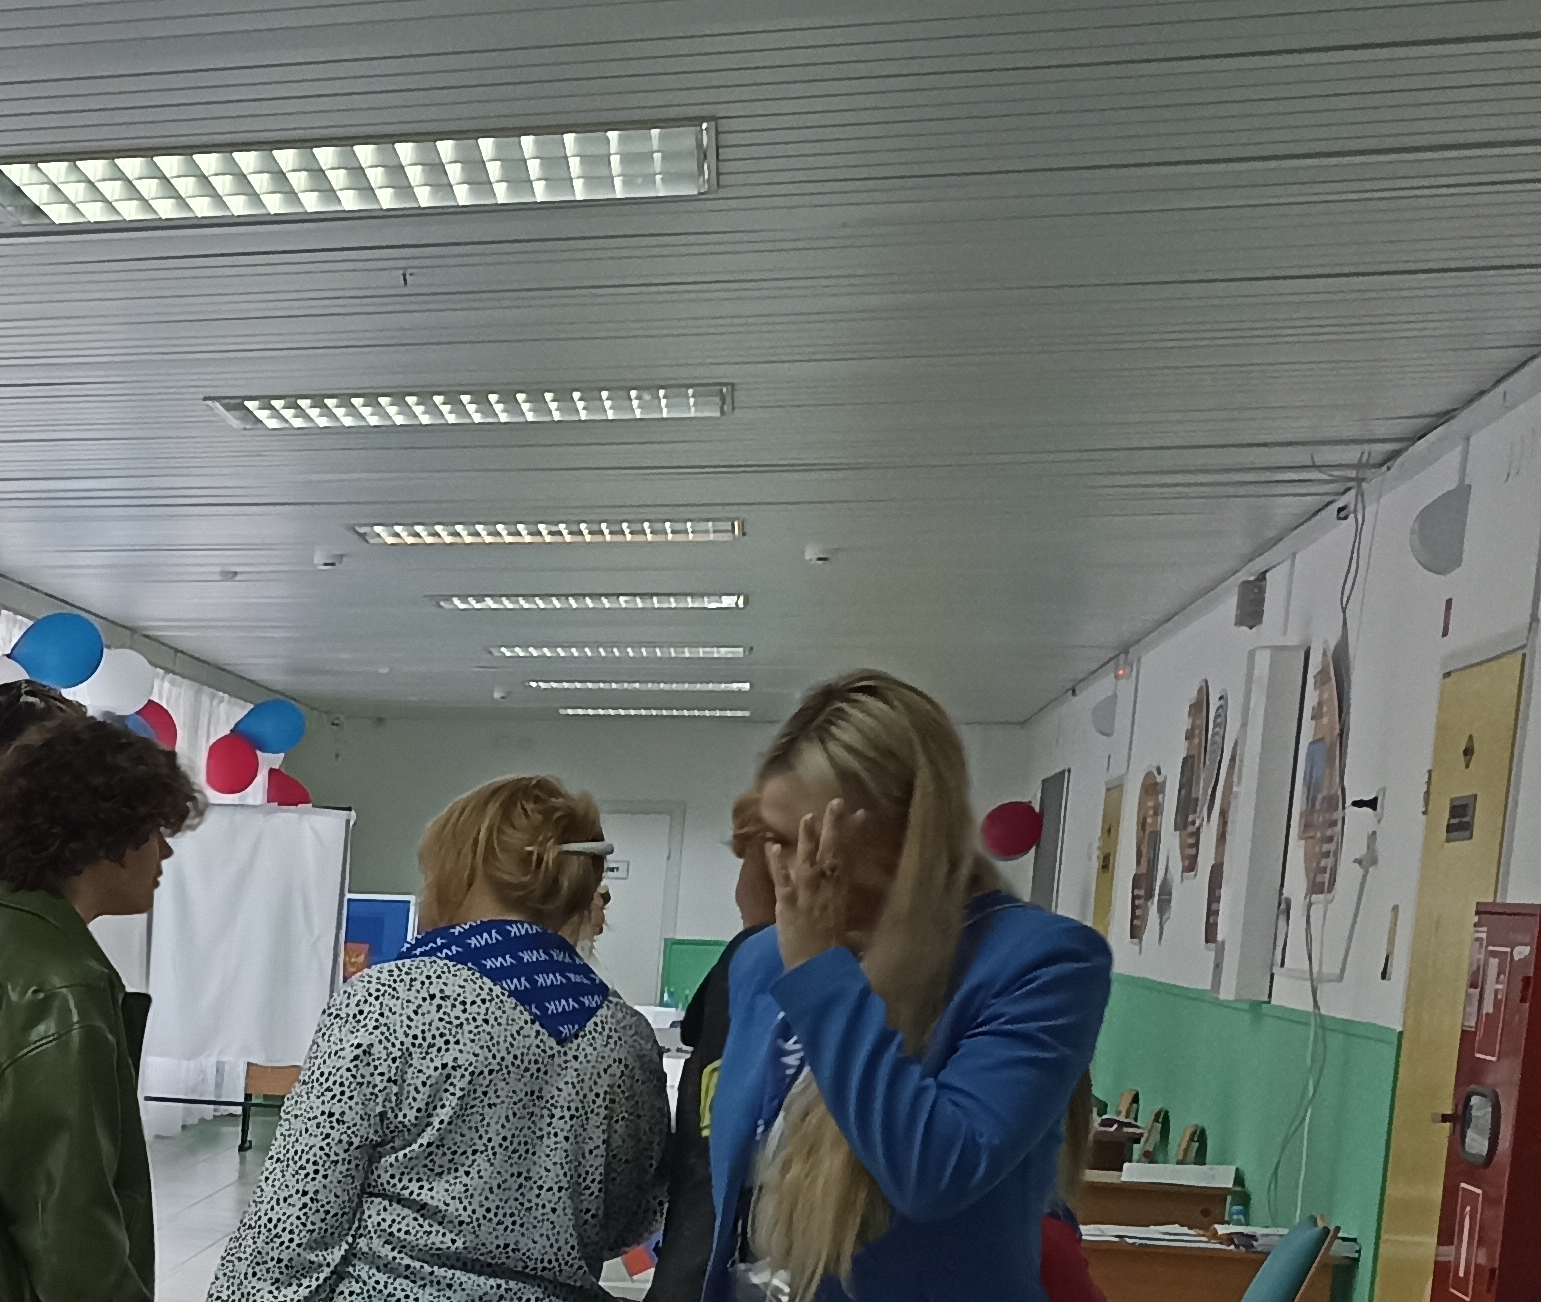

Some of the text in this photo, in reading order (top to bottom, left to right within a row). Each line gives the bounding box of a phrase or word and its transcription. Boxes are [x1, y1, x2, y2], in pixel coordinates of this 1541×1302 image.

[467, 929, 503, 949] УИК
[482, 954, 517, 970] УИК
[517, 949, 550, 964] УИК
[533, 972, 568, 987] УИК
[544, 997, 580, 1015] УИК
